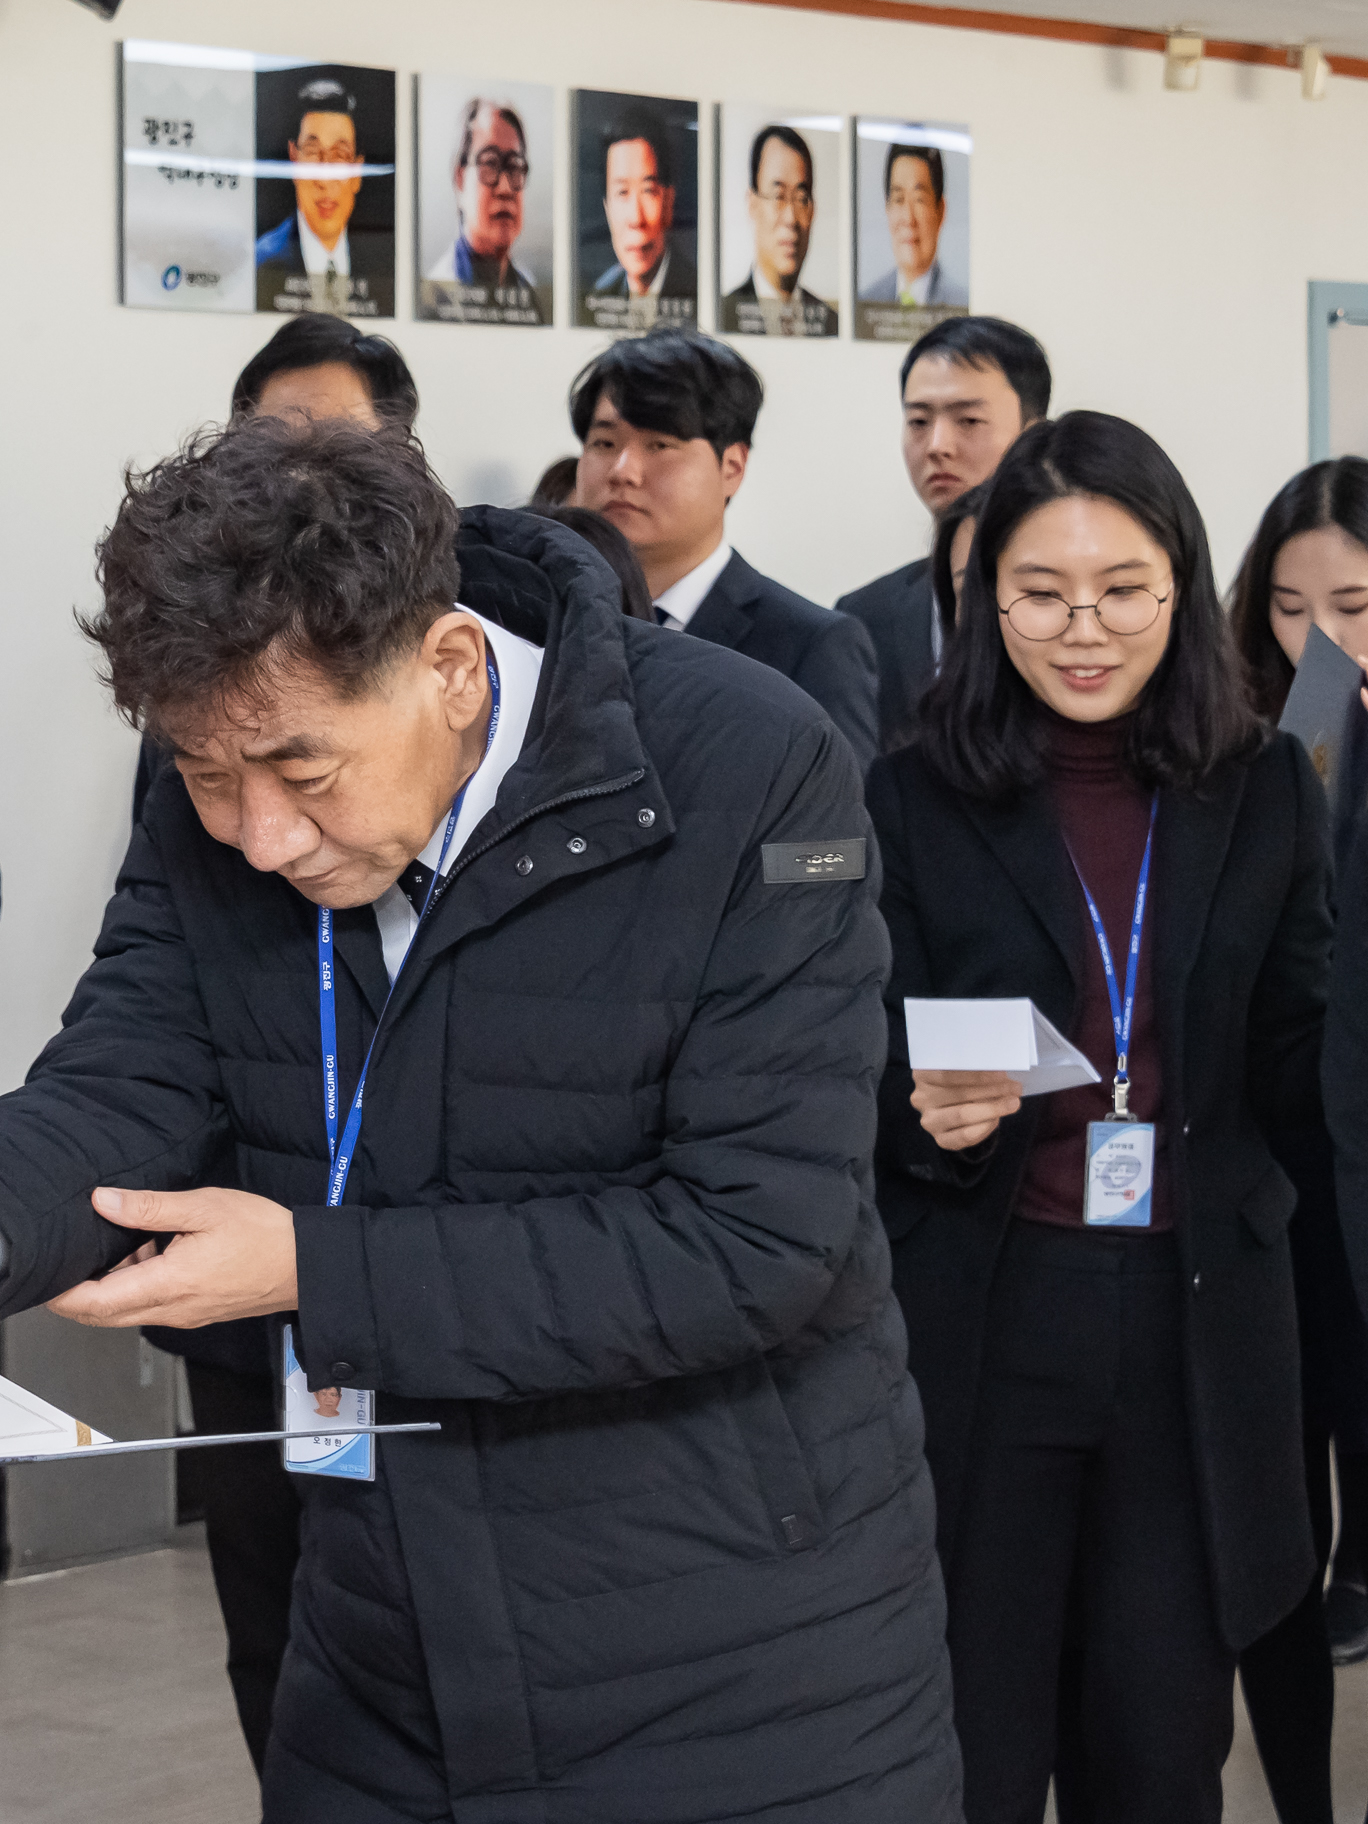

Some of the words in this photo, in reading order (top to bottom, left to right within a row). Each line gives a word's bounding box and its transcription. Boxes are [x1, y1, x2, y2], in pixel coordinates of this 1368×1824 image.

[322, 960, 333, 991] 광진구
[326, 1054, 336, 1120] GWANGJIN-GU
[329, 1155, 349, 1207] ANGJIN-GU
